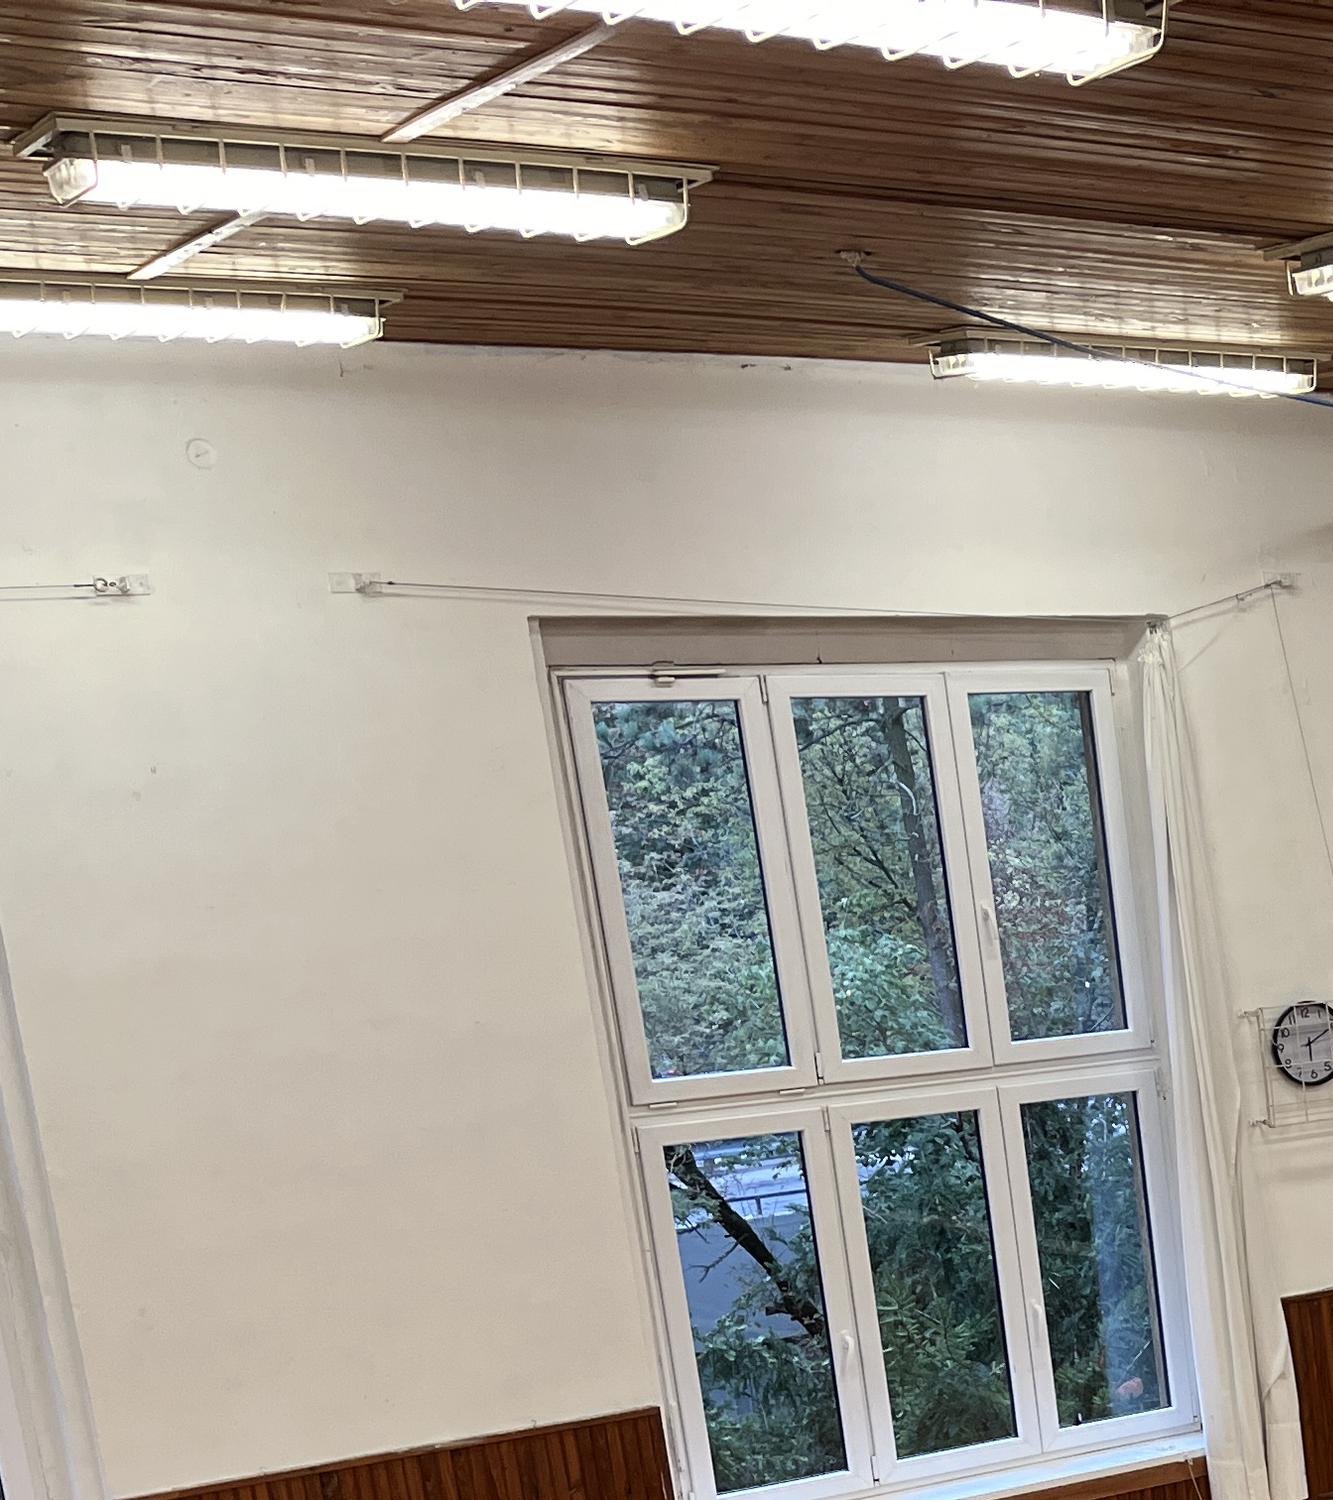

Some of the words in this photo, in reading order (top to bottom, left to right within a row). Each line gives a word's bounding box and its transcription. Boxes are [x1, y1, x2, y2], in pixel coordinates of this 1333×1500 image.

[1301, 1007, 1310, 1018] 12
[1289, 1015, 1296, 1025] 11
[1281, 1028, 1290, 1038] 10
[1277, 1044, 1284, 1053] 9
[1324, 1061, 1332, 1071] 5
[1311, 1070, 1318, 1079] 6
